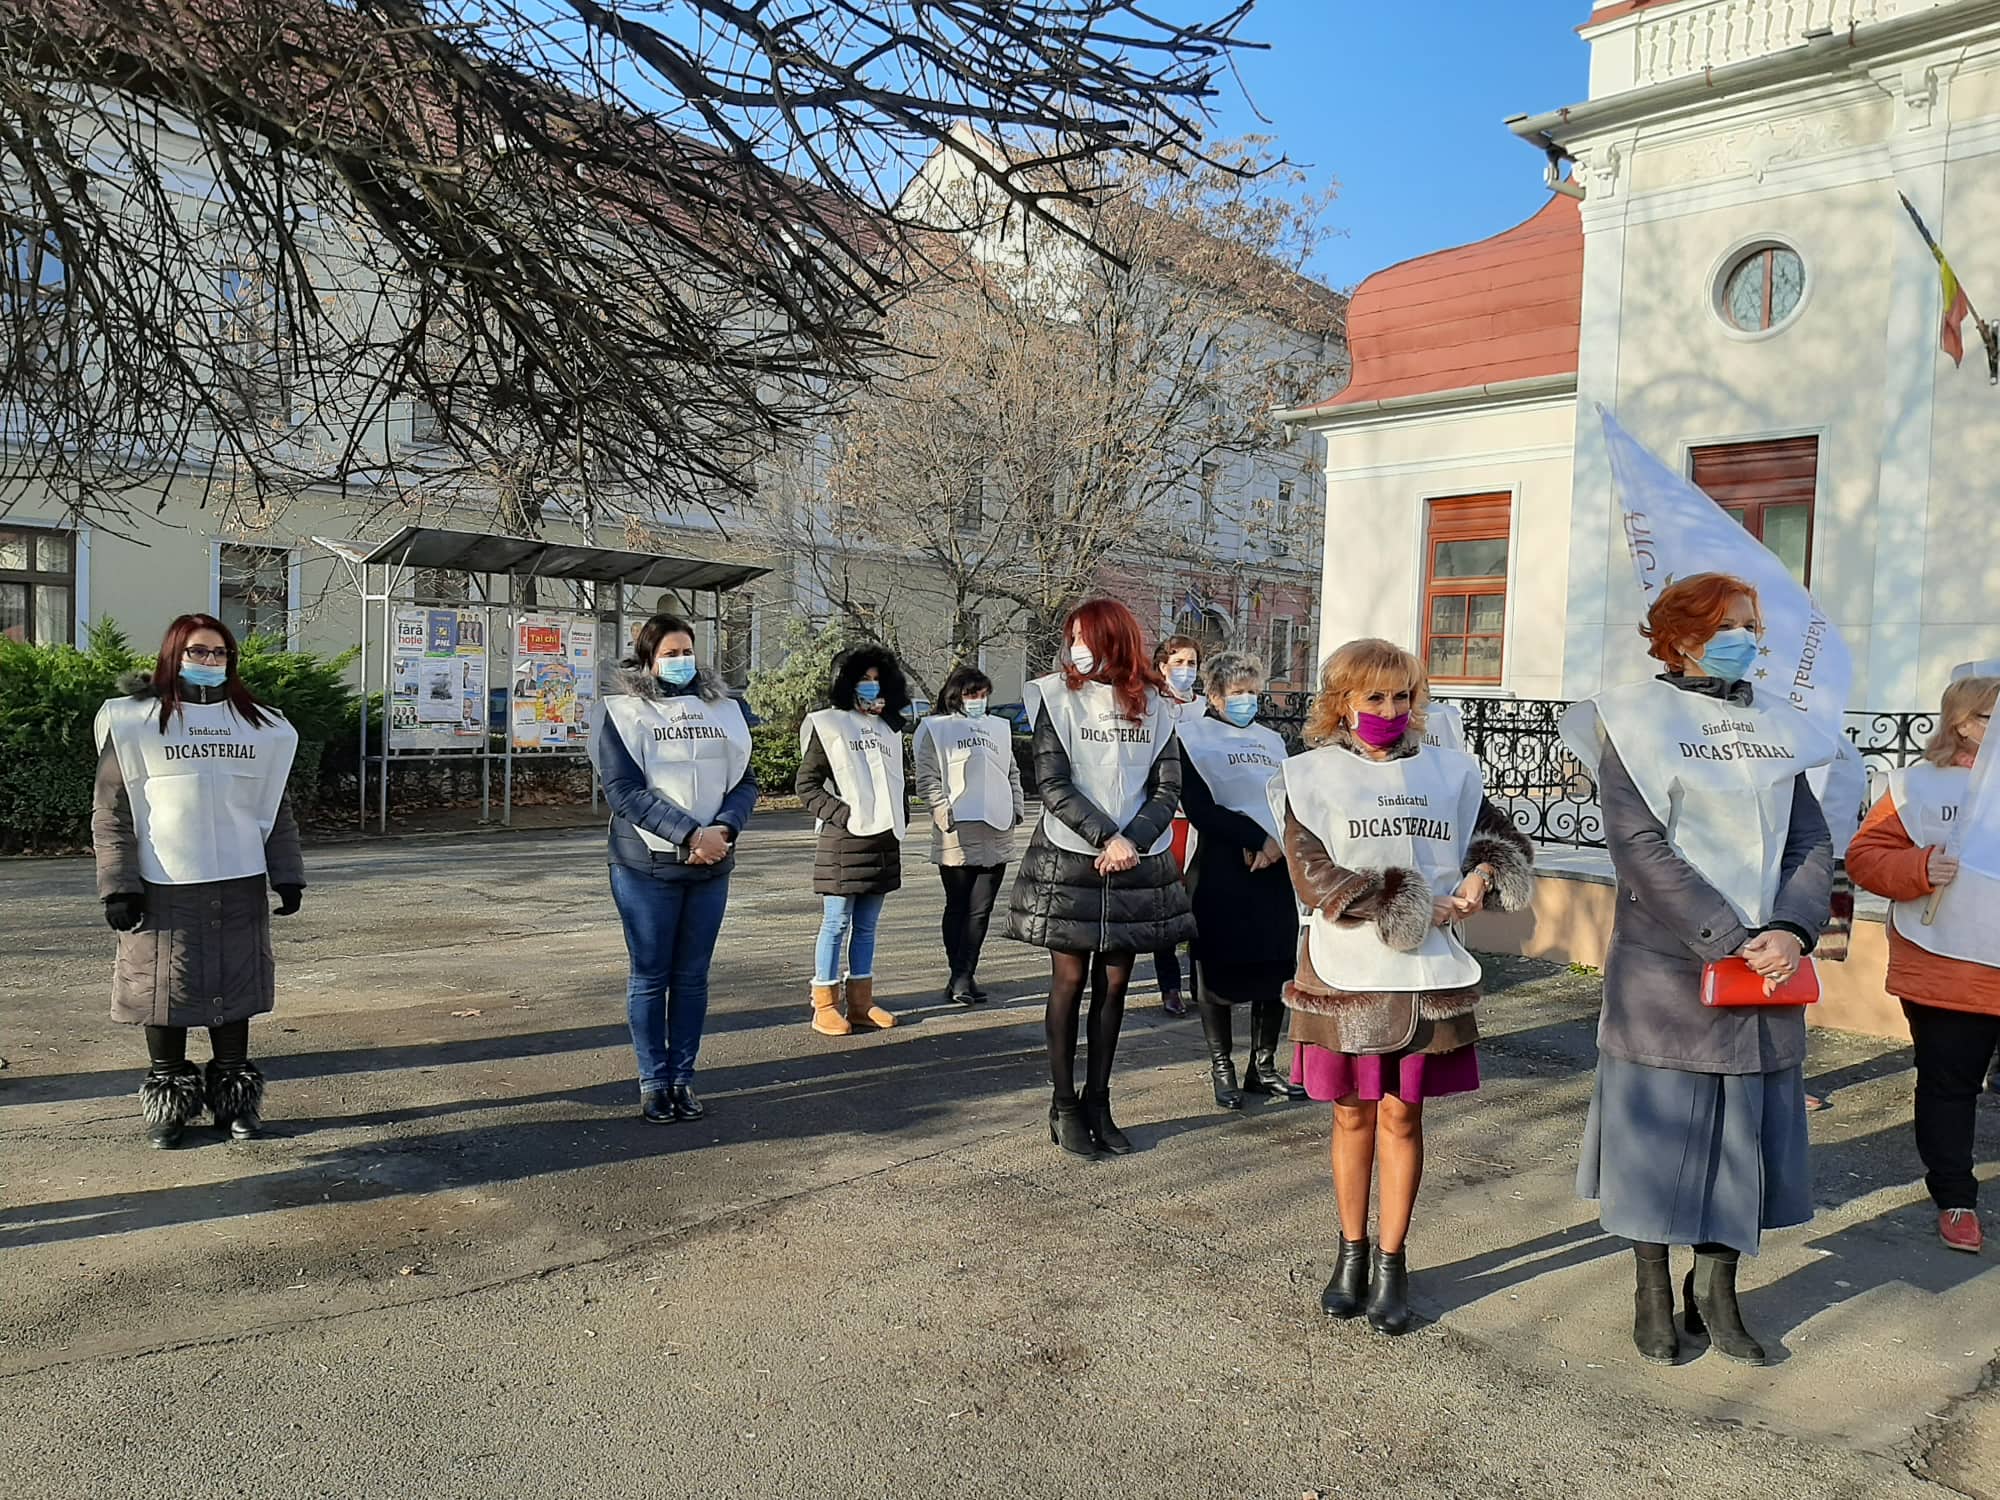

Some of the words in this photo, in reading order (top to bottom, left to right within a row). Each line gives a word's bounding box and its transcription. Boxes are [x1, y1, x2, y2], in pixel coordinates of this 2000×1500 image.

[398, 622, 423, 636] fără
[434, 639, 451, 647] PNL
[189, 726, 231, 736] Sindicatul
[653, 726, 728, 741] DICASTERIAL
[1080, 727, 1151, 743] DICASTERIAL
[1702, 719, 1755, 736] Sindicatul
[164, 743, 256, 760] DICASTERIAL
[1679, 740, 1794, 760] DICASTERIAL
[1377, 794, 1428, 807] Sindicatul
[1348, 816, 1451, 841] DICASTERIAL
